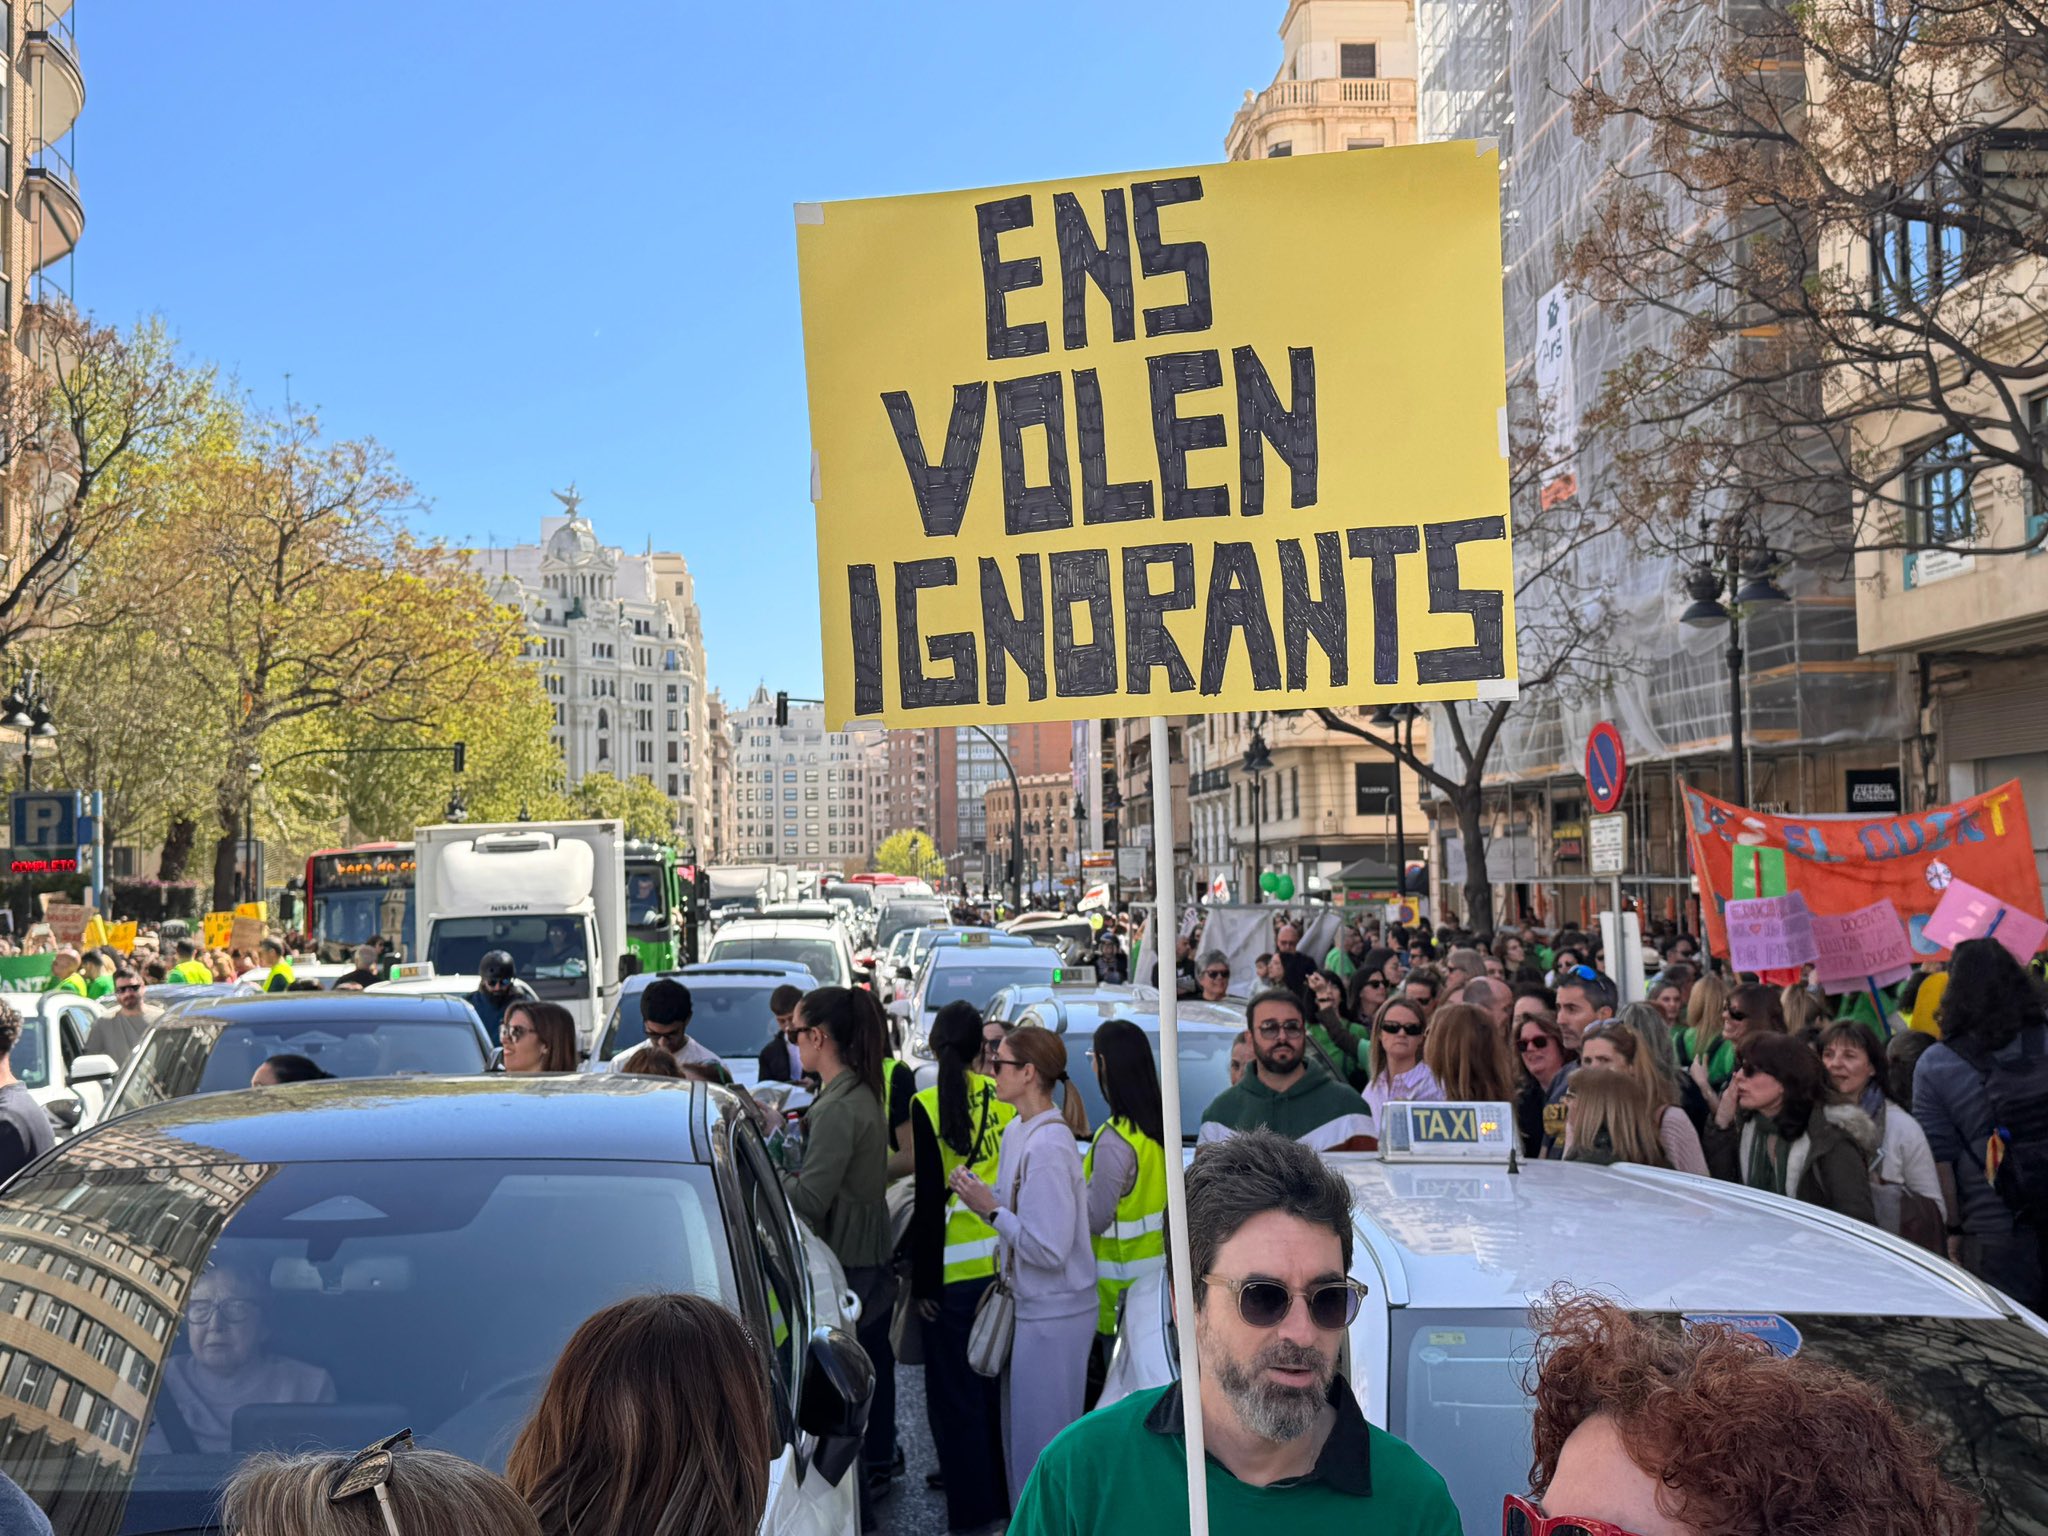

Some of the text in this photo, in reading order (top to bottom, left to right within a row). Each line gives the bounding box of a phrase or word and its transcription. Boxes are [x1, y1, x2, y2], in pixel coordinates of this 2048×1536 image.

[975, 176, 1213, 360] ENS
[880, 345, 1319, 538] VOLEN
[847, 515, 1506, 715] IGNORANTS
[11, 859, 77, 873] COMPLETO
[25, 801, 62, 844] P
[1413, 1109, 1477, 1141] TAXI
